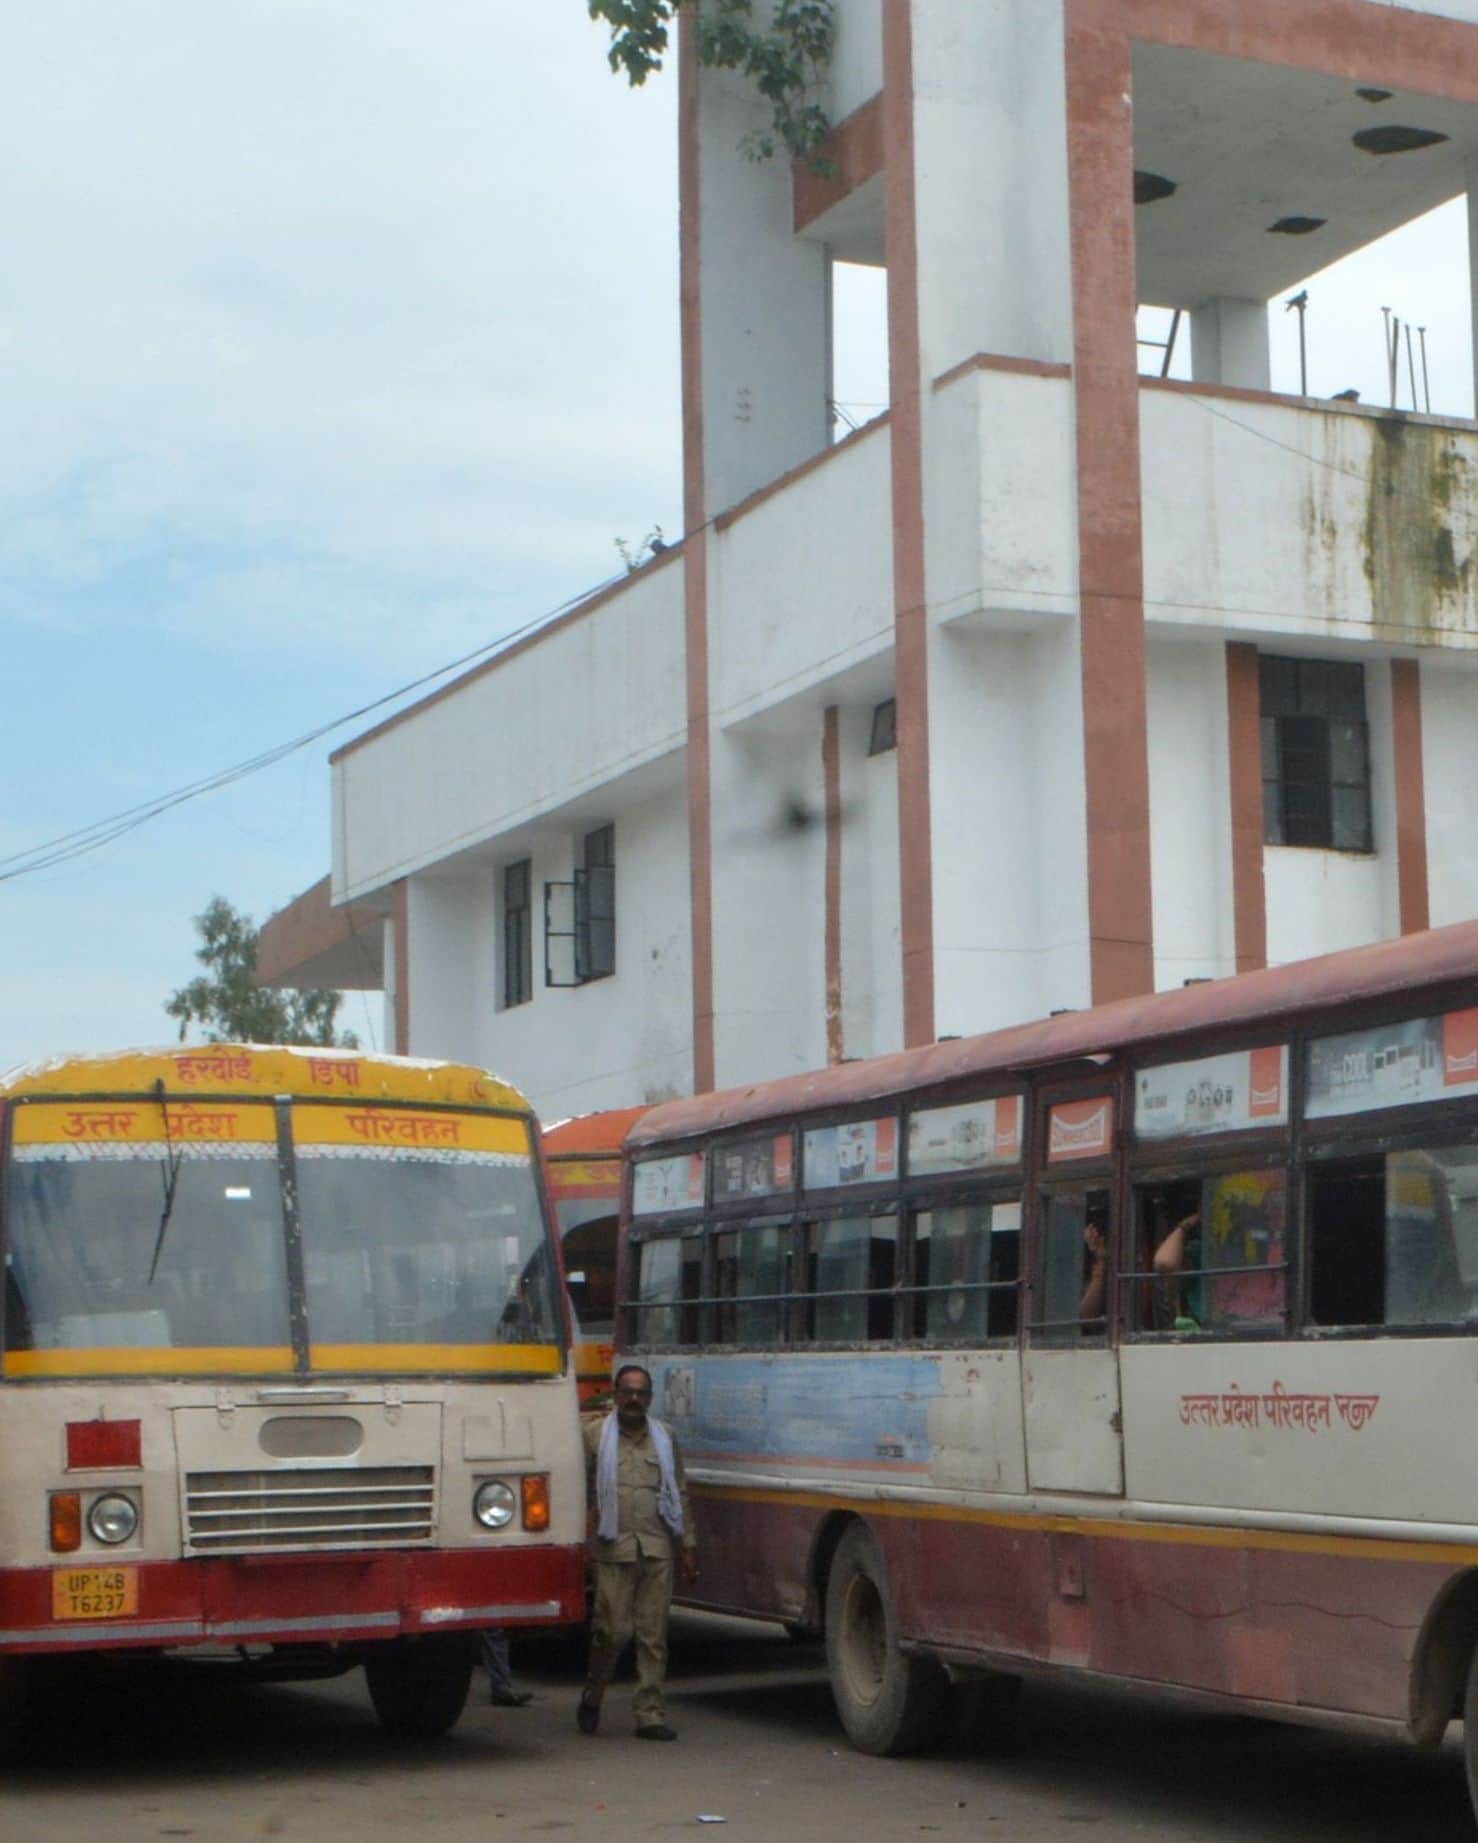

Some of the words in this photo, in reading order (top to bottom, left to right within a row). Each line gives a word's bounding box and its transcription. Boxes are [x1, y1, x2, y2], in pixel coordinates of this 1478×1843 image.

[174, 1047, 252, 1083] हरदोई
[62, 1112, 137, 1137] उत्तर
[160, 1104, 237, 1138] प्रदेश
[345, 1107, 460, 1143] परिवहन
[1180, 1395, 1220, 1427] उत्तर
[1221, 1382, 1260, 1428] प्रदेश
[1262, 1379, 1332, 1433] परिवहन
[70, 1592, 125, 1613] T6237
